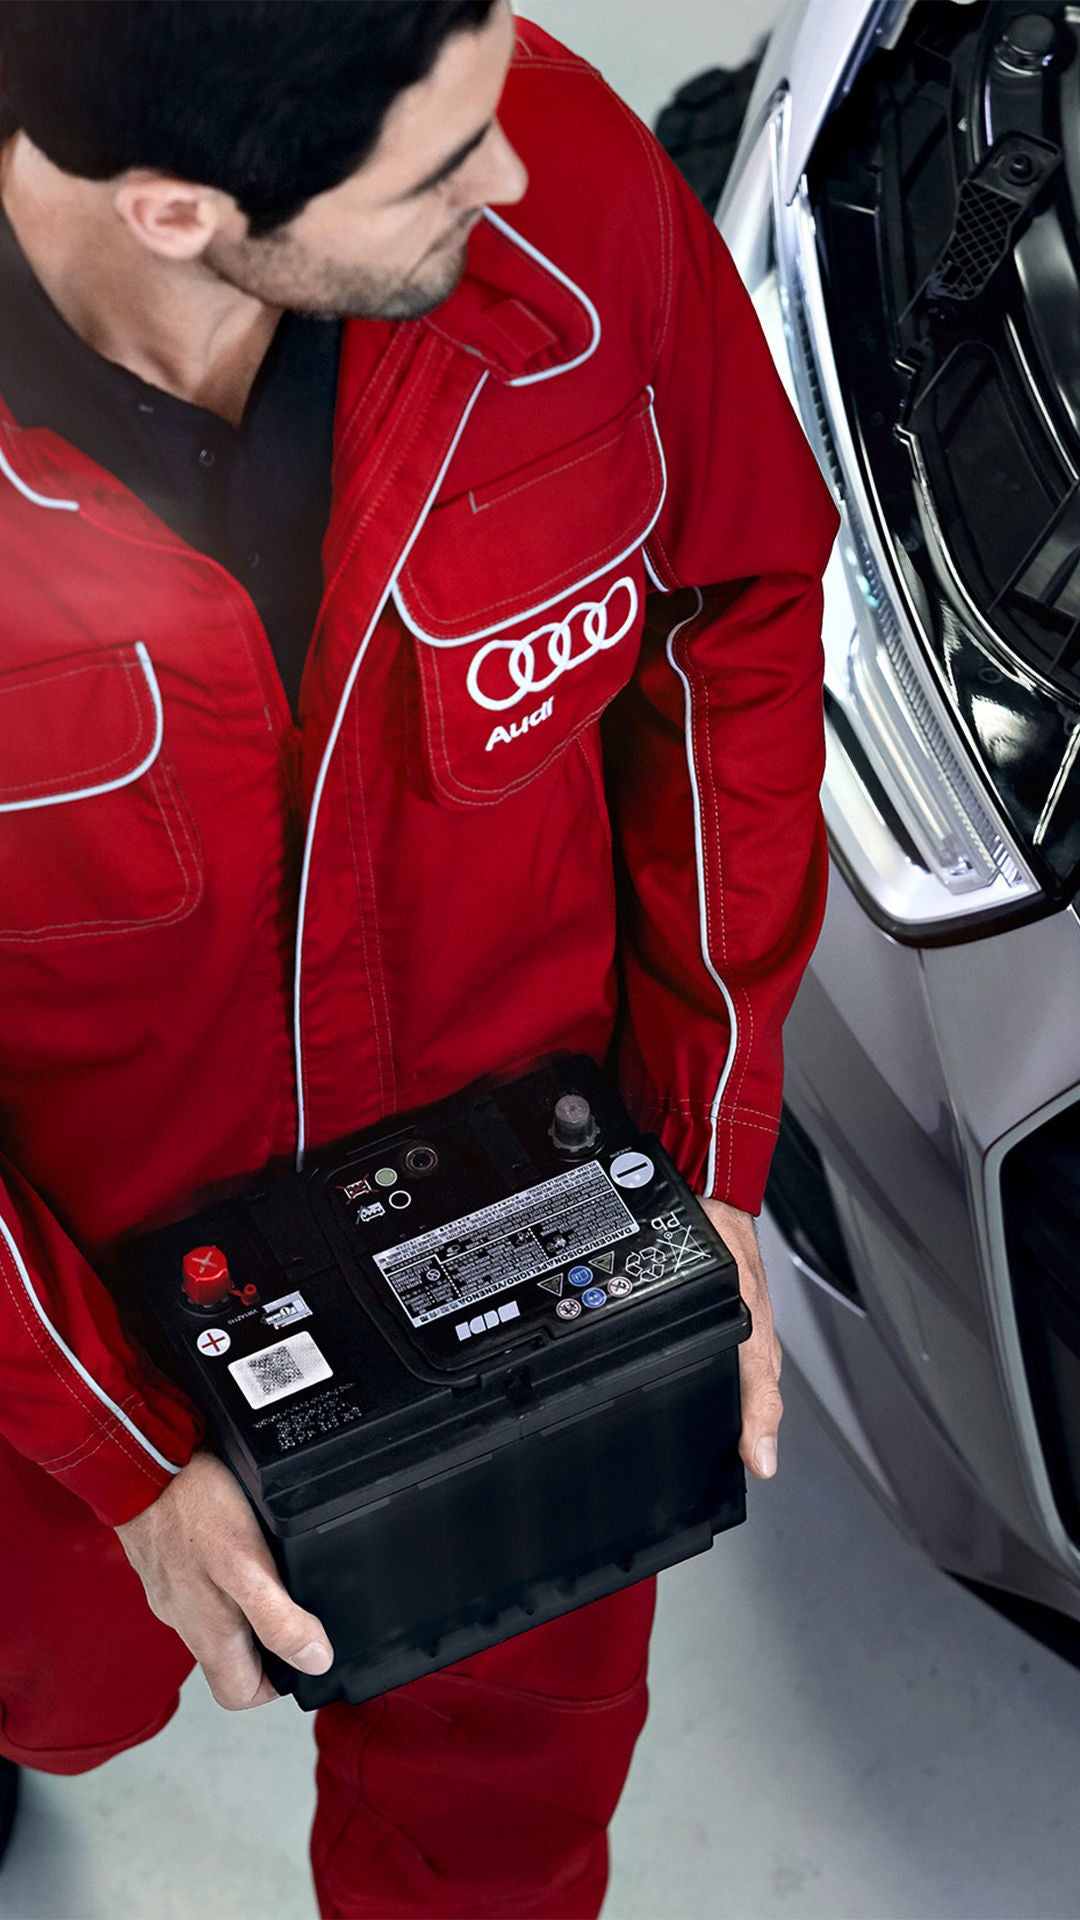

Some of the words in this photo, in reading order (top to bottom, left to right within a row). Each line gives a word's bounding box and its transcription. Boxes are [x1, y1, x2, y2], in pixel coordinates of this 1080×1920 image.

[485, 696, 554, 751] Audi
[650, 1211, 681, 1230] Pb
[551, 1225, 632, 1266] DANGER/POISON
[464, 1261, 548, 1304] PELIGRO/VENENO
